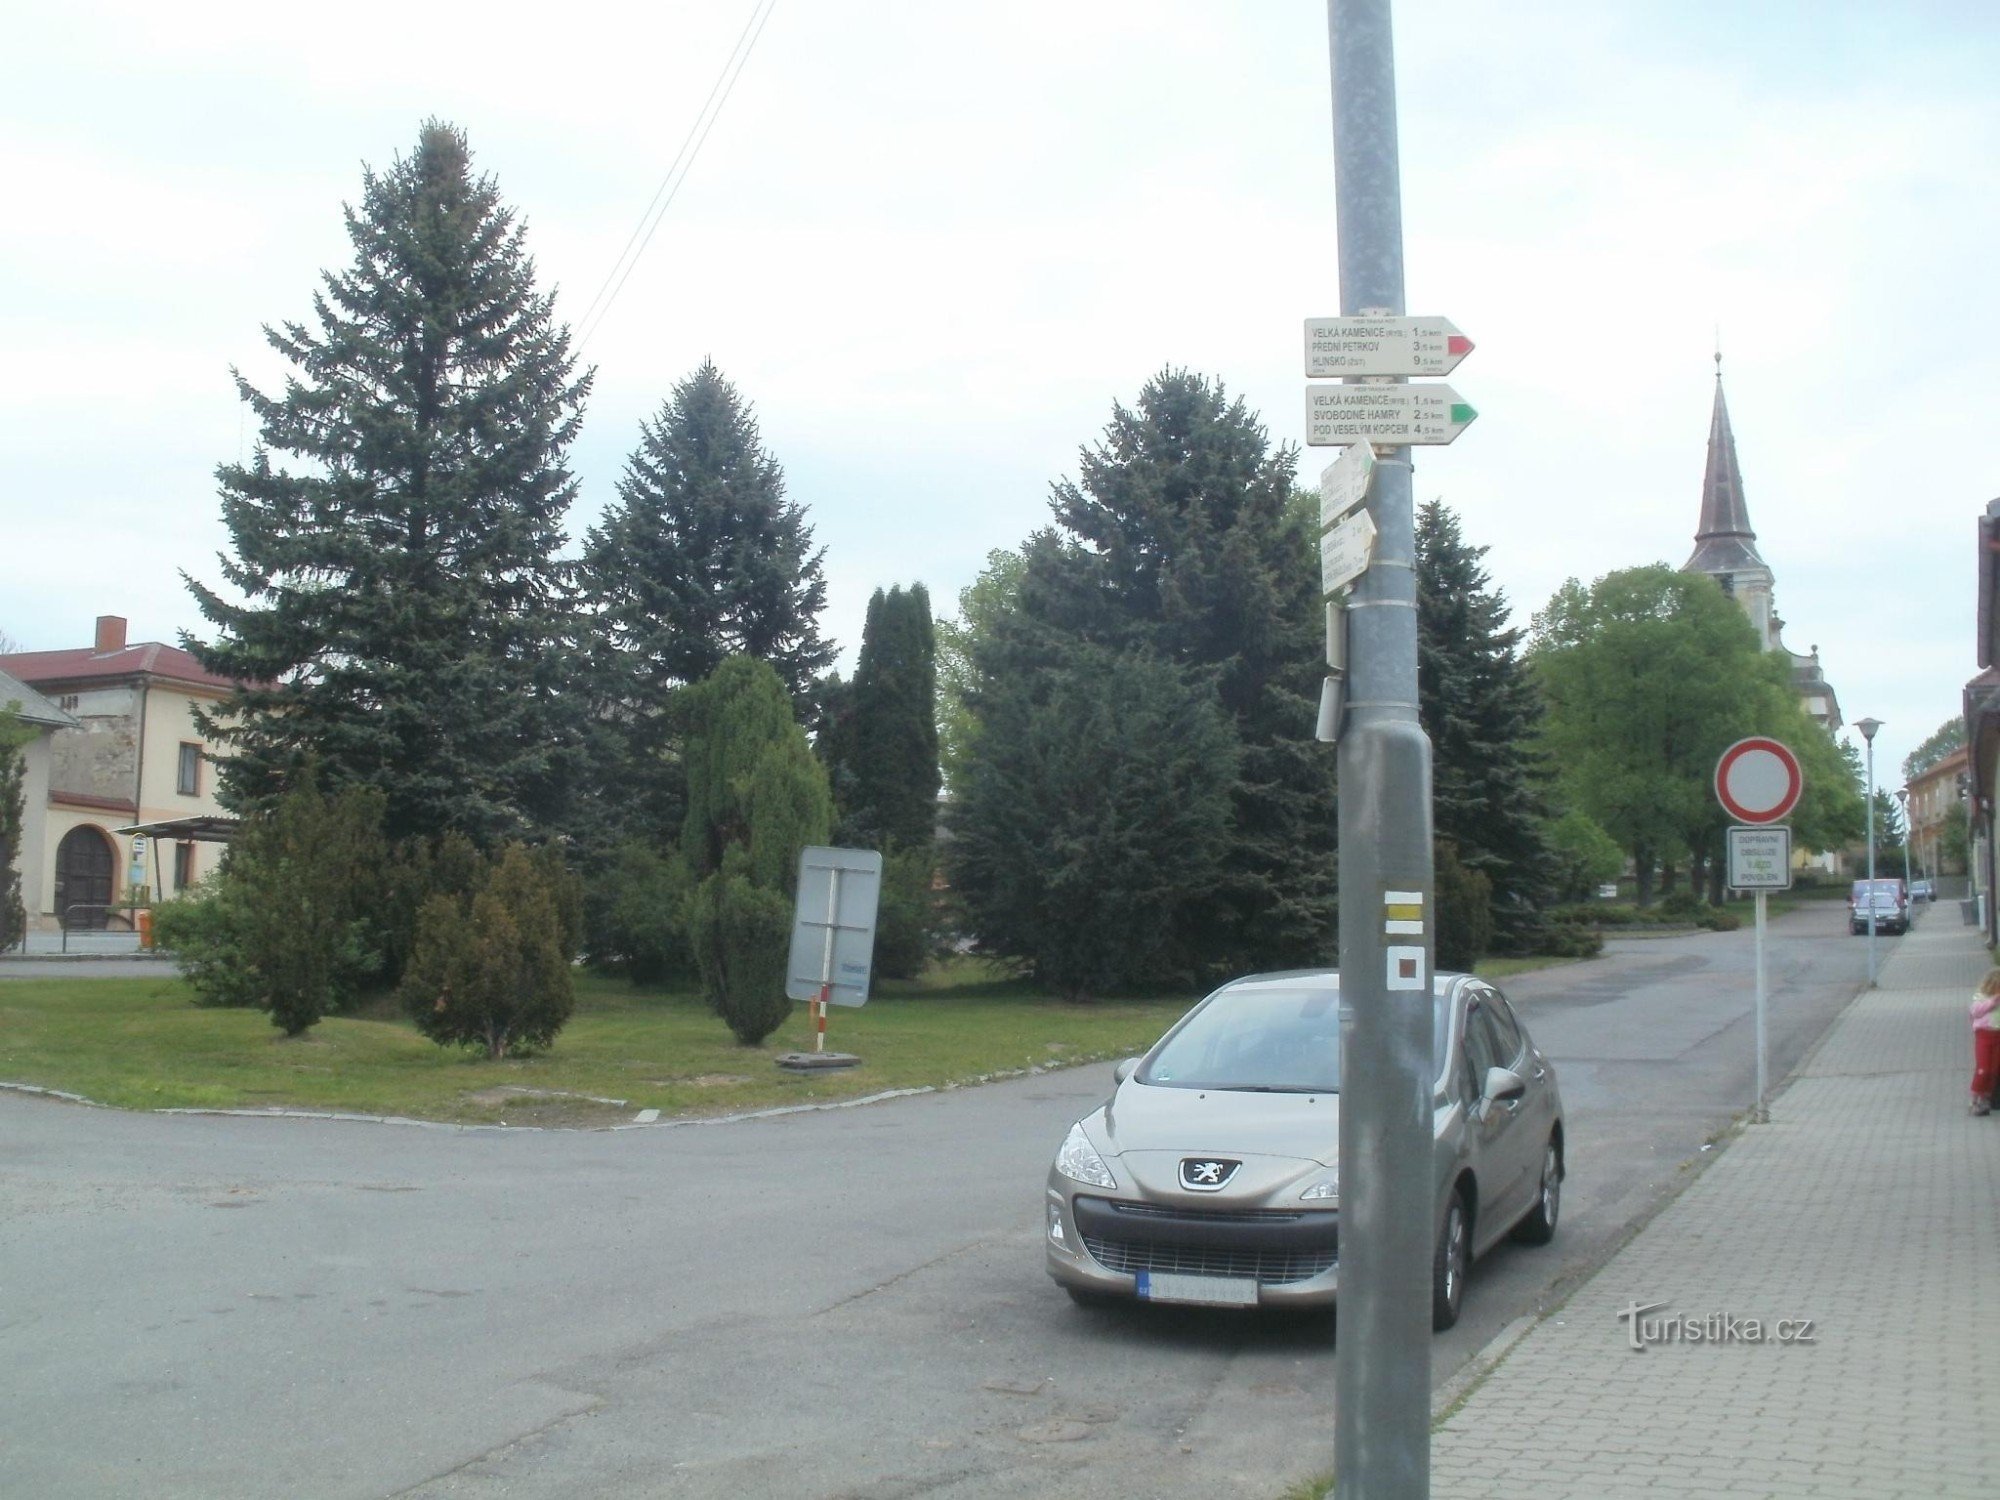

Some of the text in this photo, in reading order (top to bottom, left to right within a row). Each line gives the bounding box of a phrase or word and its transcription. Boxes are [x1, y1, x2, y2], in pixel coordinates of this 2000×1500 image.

[1312, 326, 1340, 337] VELKÁ
[1341, 328, 1385, 337] KAMENICE
[1312, 341, 1341, 352] PŘEDNÍ
[1343, 343, 1379, 352] PETRKOV
[1312, 356, 1346, 366] HLINSKO
[1313, 394, 1341, 405] VELKÁ
[1343, 396, 1389, 405] KAMENICE
[1313, 408, 1365, 420] SVOBODNÉ
[1367, 410, 1400, 420] HAMRY
[1313, 425, 1331, 435] POD
[1332, 423, 1372, 434] VESELÝM
[1373, 425, 1408, 434] KOPCEM
